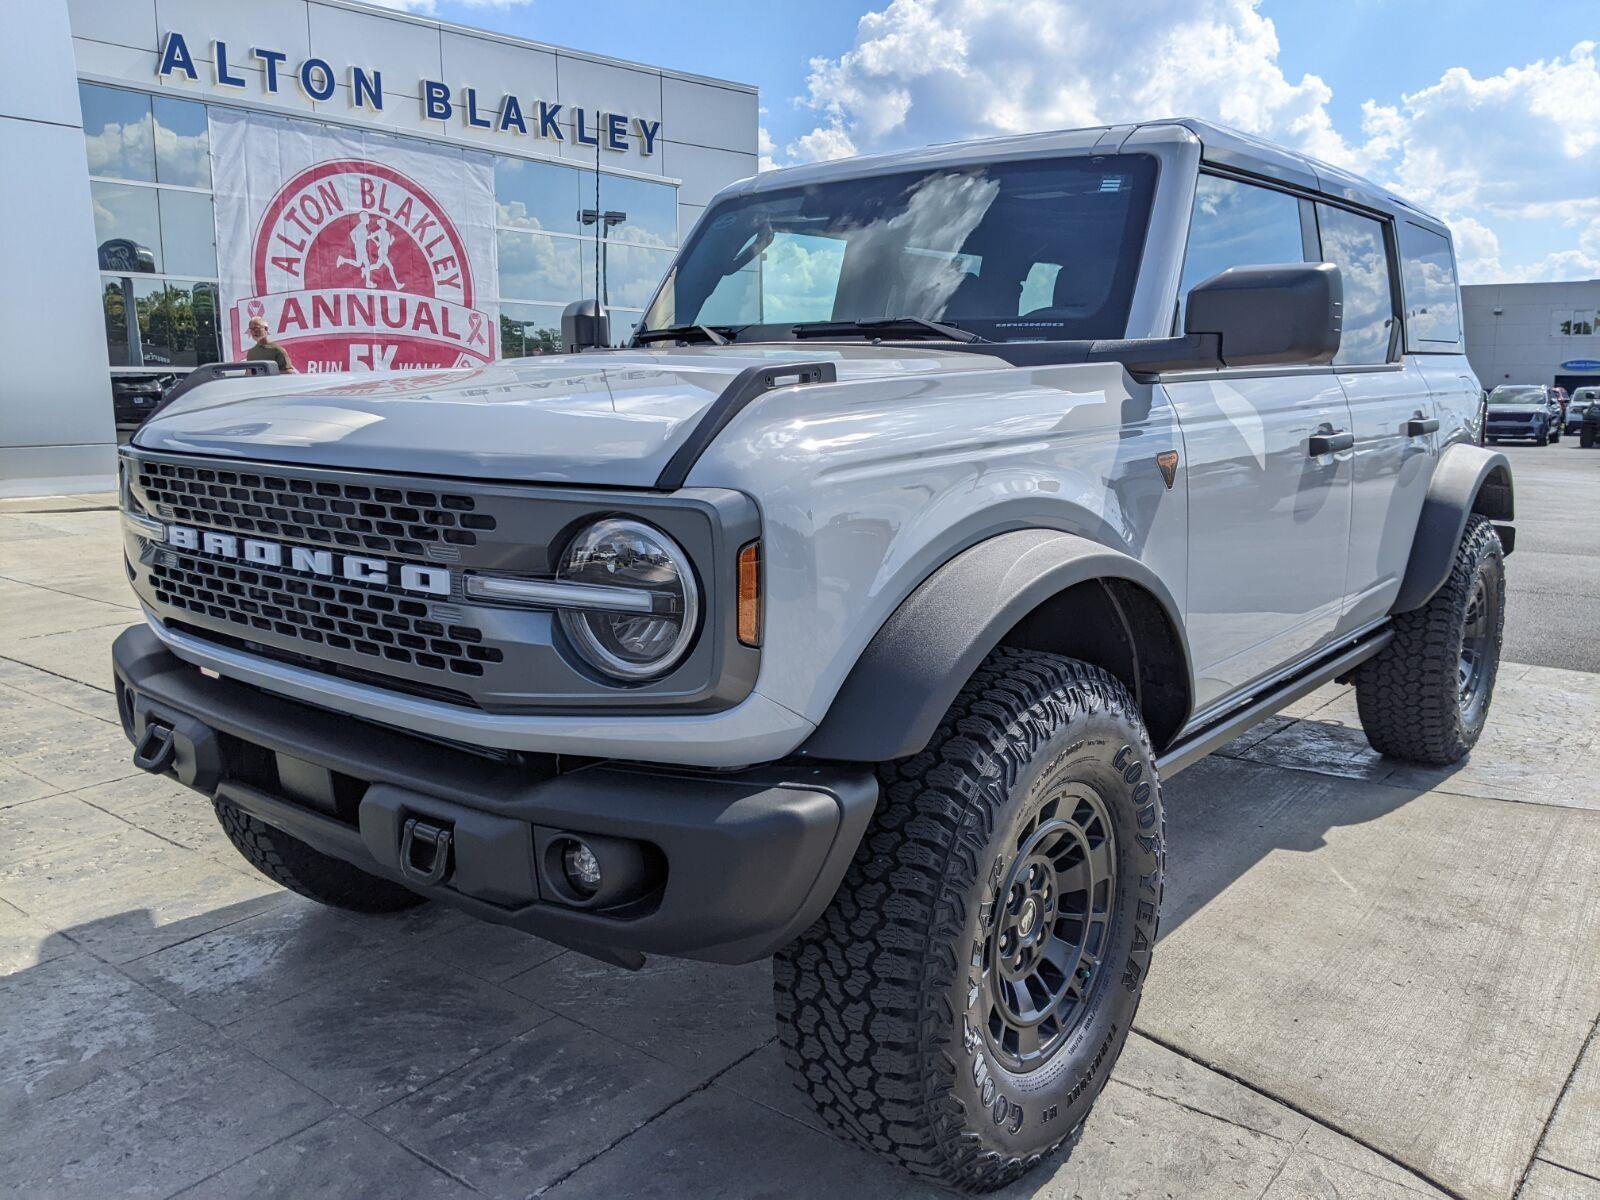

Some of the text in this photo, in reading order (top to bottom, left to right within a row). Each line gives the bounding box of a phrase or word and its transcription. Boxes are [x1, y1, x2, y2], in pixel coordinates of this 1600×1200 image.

[158, 31, 664, 156] ALTON BLAKLEY
[271, 177, 462, 290] ALTON BLAKLEY
[276, 293, 462, 341] ANNUAL
[168, 524, 451, 597] BRONCO
[1113, 744, 1160, 993] GOODYEAR
